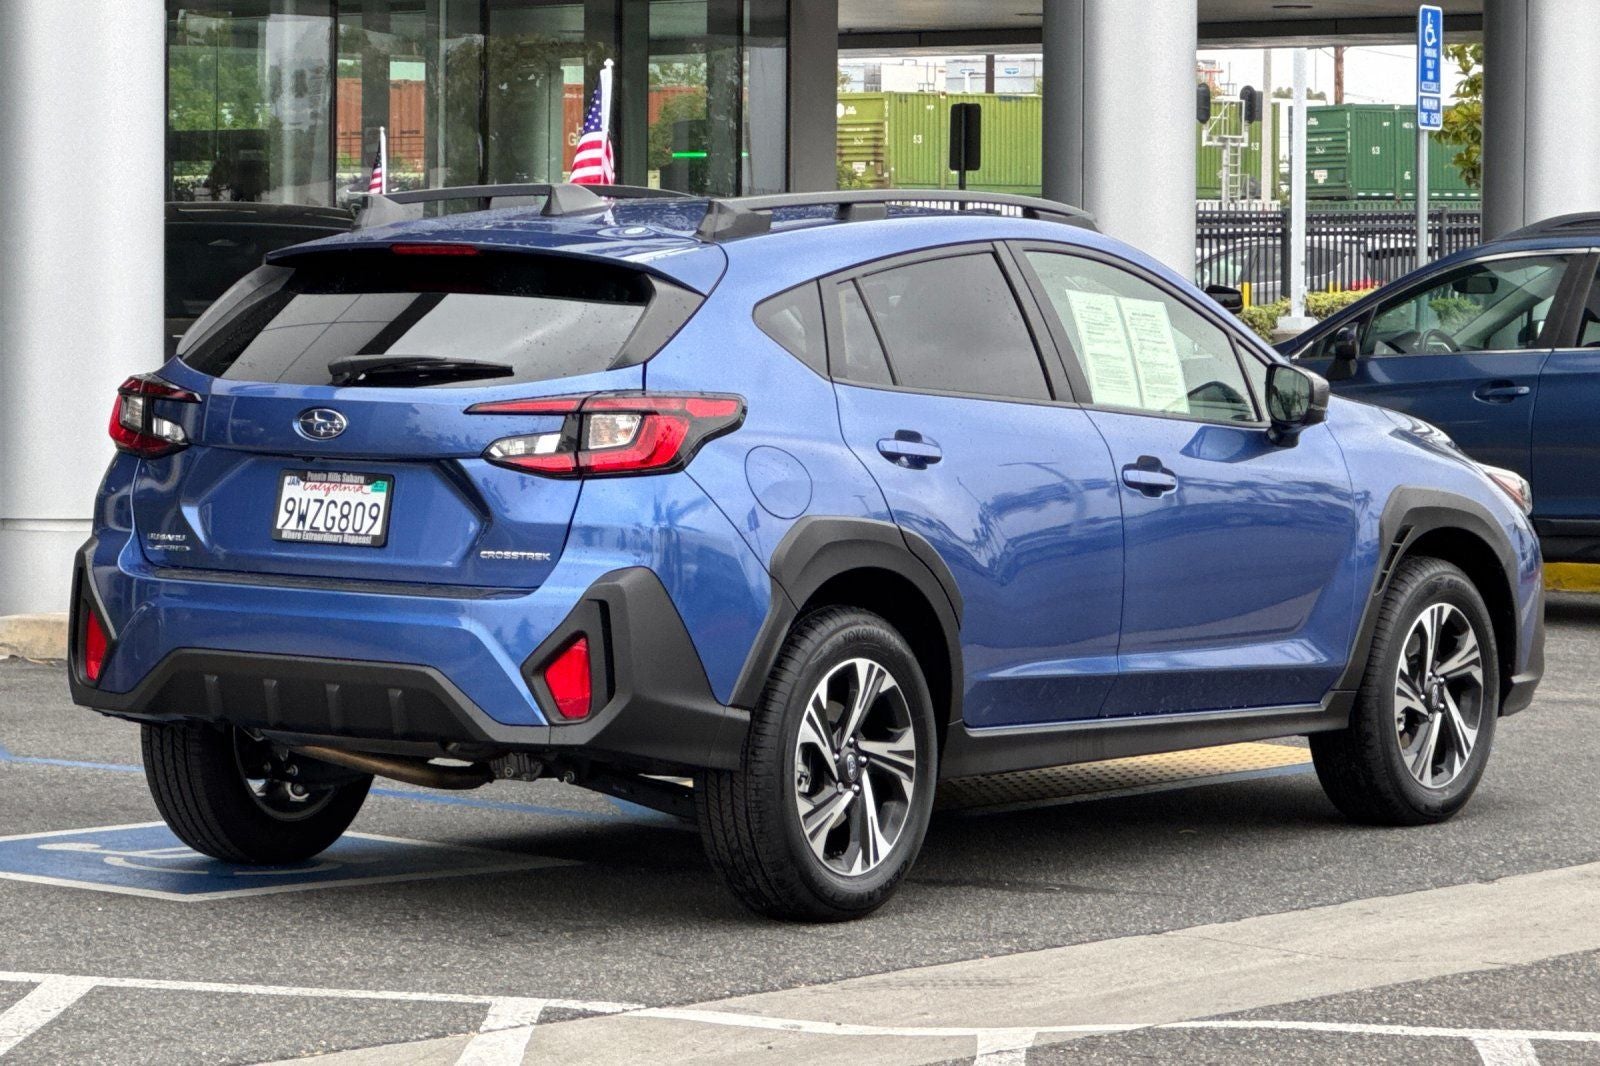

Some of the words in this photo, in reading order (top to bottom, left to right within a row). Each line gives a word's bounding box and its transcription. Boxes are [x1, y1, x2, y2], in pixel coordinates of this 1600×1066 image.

[287, 476, 300, 486] JAN
[306, 471, 328, 481] Puente
[327, 472, 341, 482] Hills
[342, 473, 365, 484] Subaru
[302, 480, 371, 497] California
[281, 497, 381, 534] 9WZG809
[281, 530, 301, 540] Where
[302, 531, 343, 543] Extraordinary
[480, 550, 551, 562] CROSSTREK
